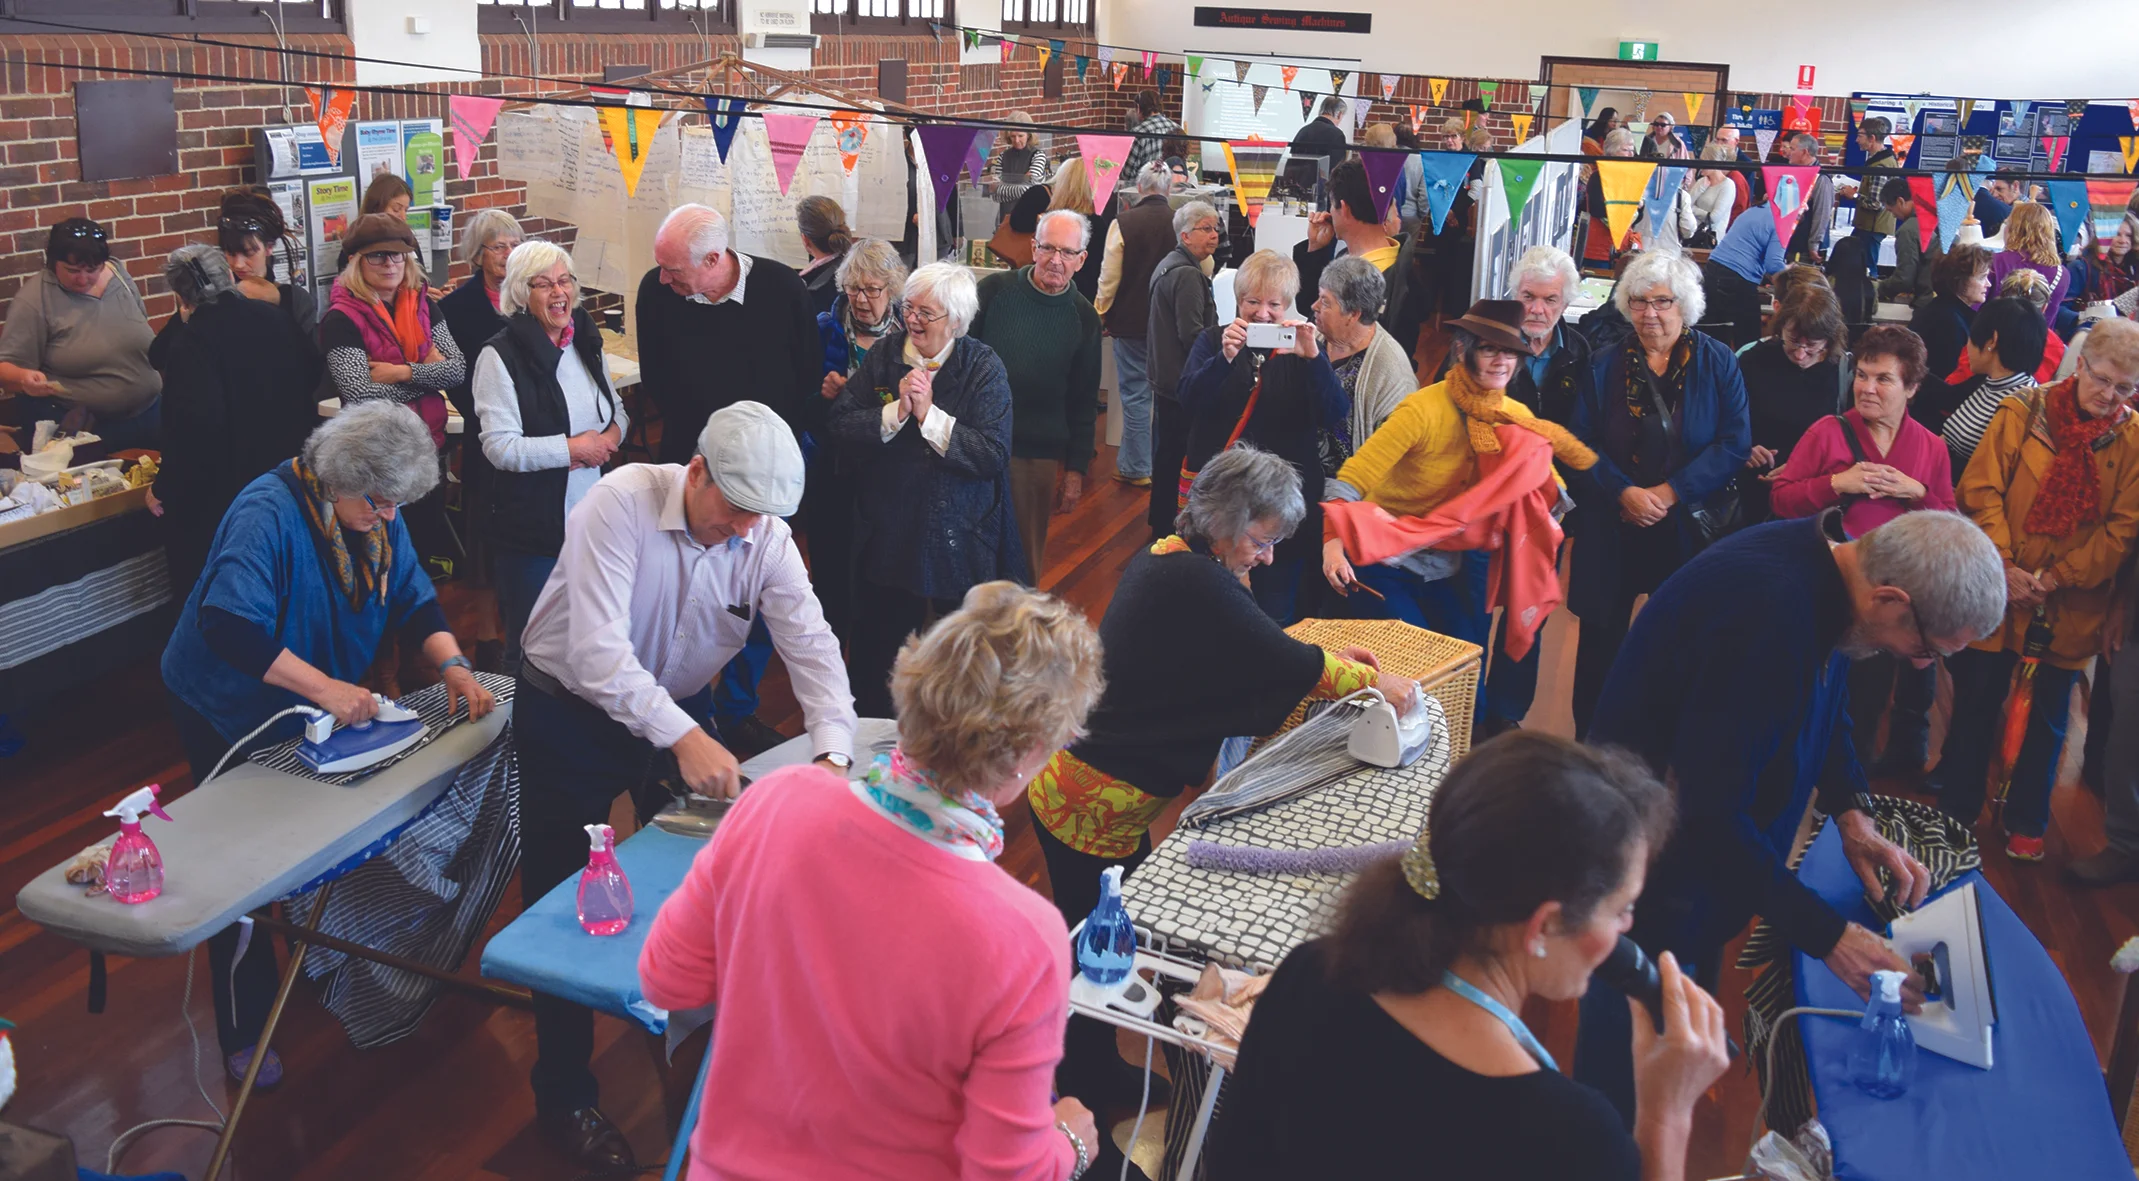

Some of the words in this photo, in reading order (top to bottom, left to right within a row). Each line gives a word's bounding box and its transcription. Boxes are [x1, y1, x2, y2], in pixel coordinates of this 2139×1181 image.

[1219, 11, 1256, 25] Antique
[1261, 13, 1297, 27] Sewing
[1301, 15, 1346, 28] Machines
[316, 186, 332, 195] Story
[332, 185, 349, 193] Time
